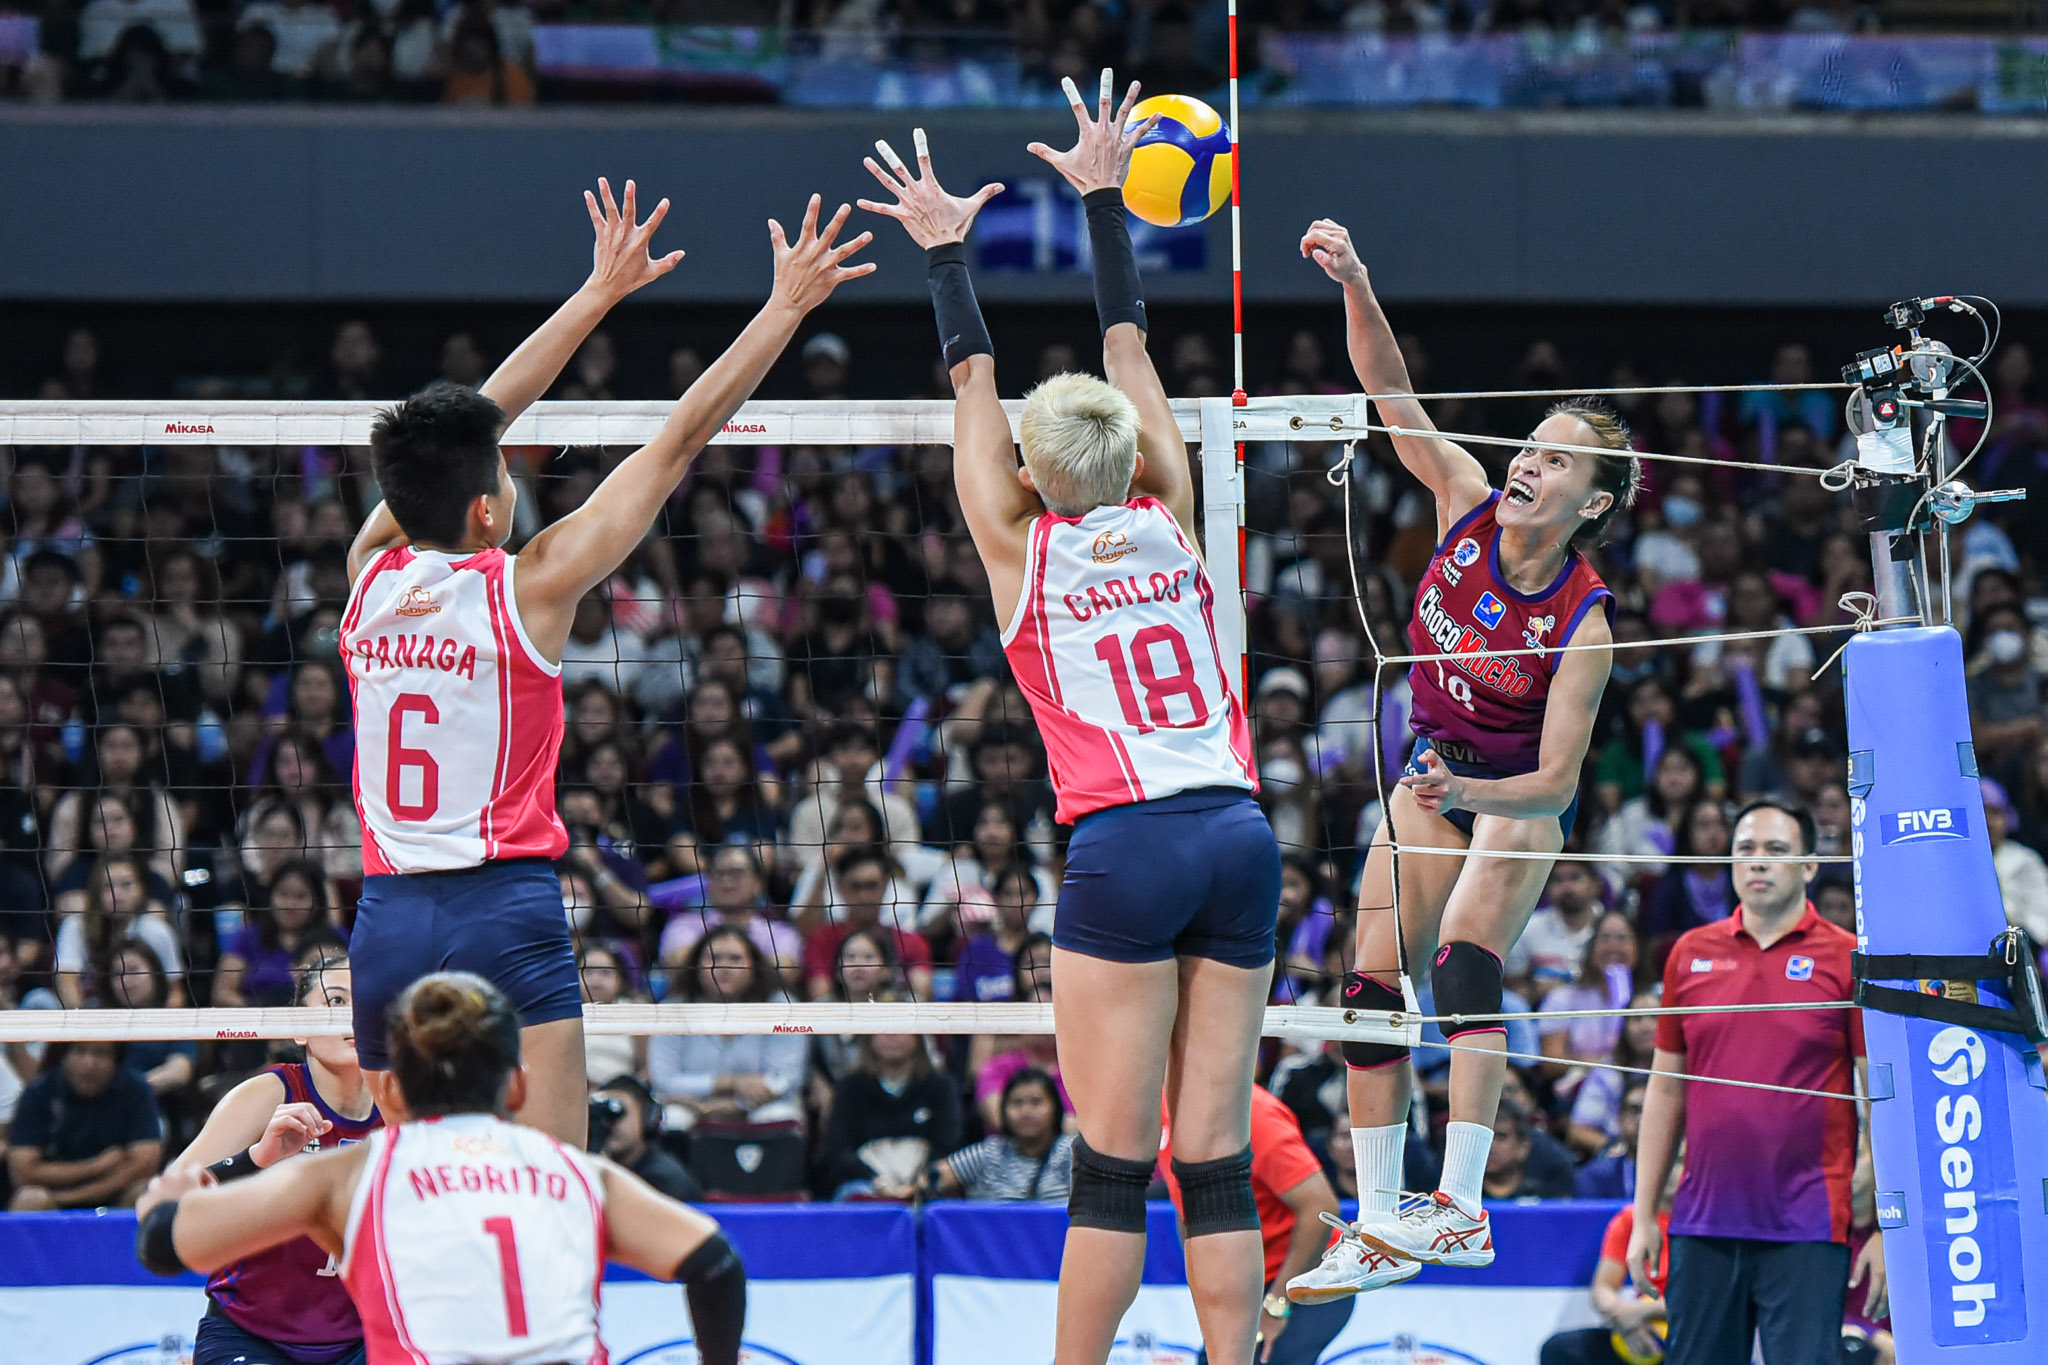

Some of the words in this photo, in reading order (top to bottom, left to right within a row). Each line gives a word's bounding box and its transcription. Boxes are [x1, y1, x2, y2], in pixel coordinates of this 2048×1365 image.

[1091, 546, 1138, 564] Rebisco
[395, 605, 442, 617] Rebisco
[1063, 569, 1188, 622] CARLOS
[356, 634, 476, 681] PANAGA
[1094, 623, 1209, 735] 18
[386, 693, 440, 822] 6
[1897, 808, 1952, 832] FIVB
[409, 1165, 567, 1201] NEGRITO
[1878, 1205, 1902, 1219] noh
[1935, 1094, 1997, 1328] Senoh
[483, 1216, 528, 1337] 1
